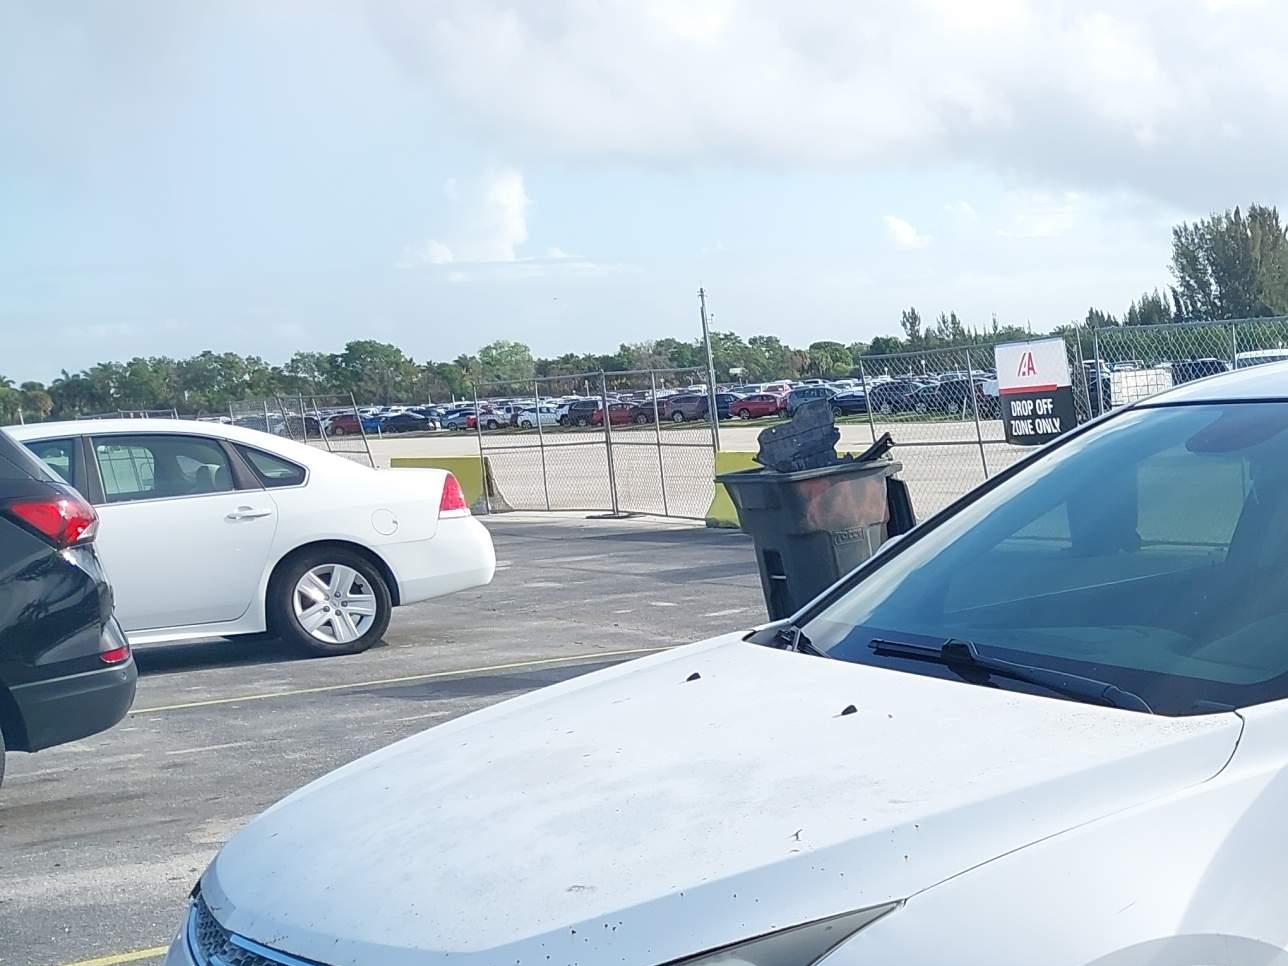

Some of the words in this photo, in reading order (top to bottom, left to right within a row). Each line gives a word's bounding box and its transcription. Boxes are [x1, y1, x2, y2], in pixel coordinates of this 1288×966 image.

[1010, 400, 1034, 417] DROP
[1035, 398, 1054, 415] OFF
[1010, 419, 1035, 436] ZONE
[1035, 417, 1062, 434] ONLY
